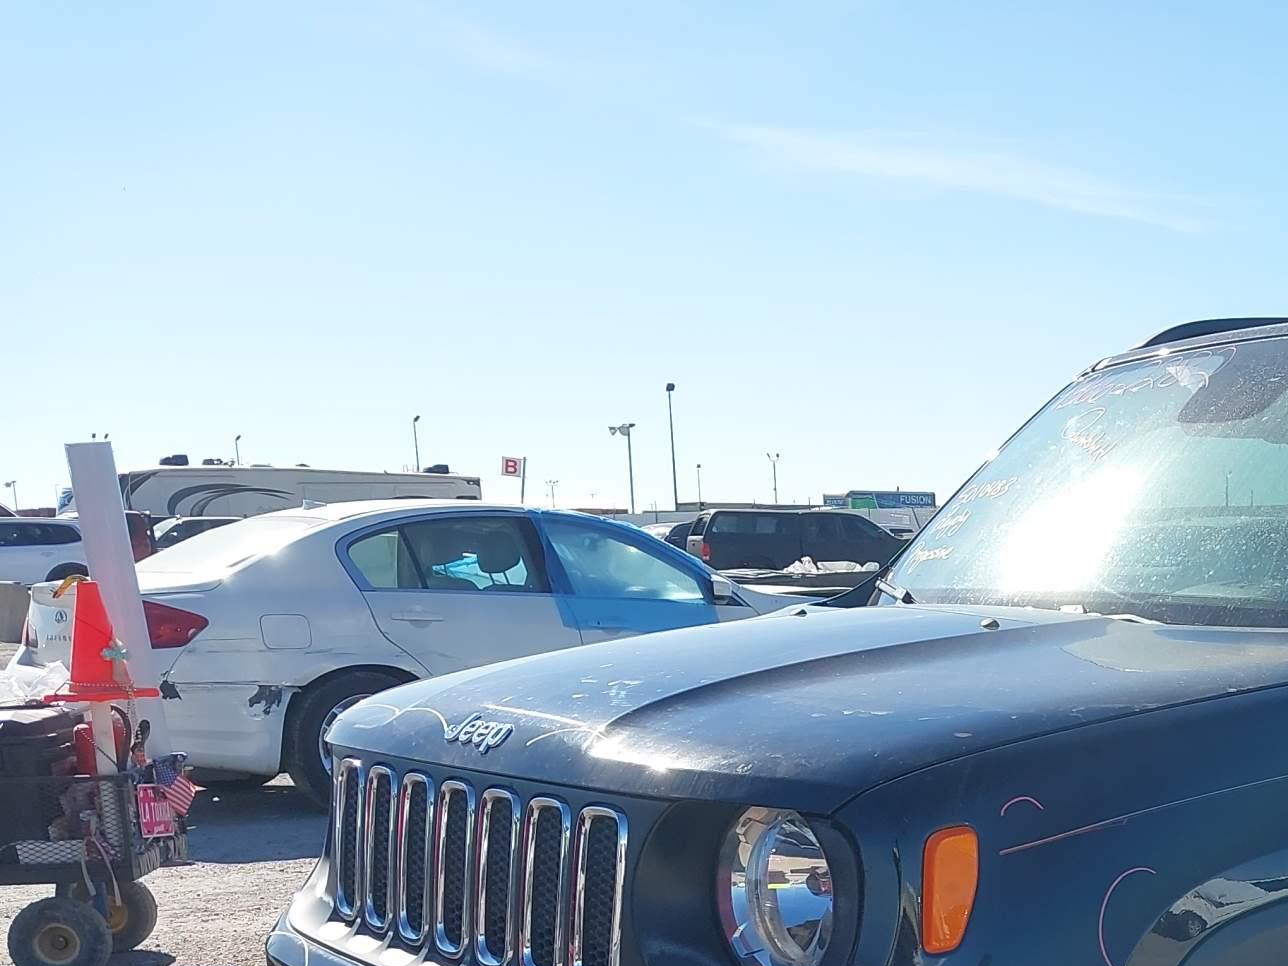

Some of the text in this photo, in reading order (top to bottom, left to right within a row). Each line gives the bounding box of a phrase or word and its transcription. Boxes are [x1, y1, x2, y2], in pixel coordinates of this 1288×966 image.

[505, 458, 518, 475] B
[900, 495, 932, 505] FUSION
[444, 711, 515, 755] Jeep
